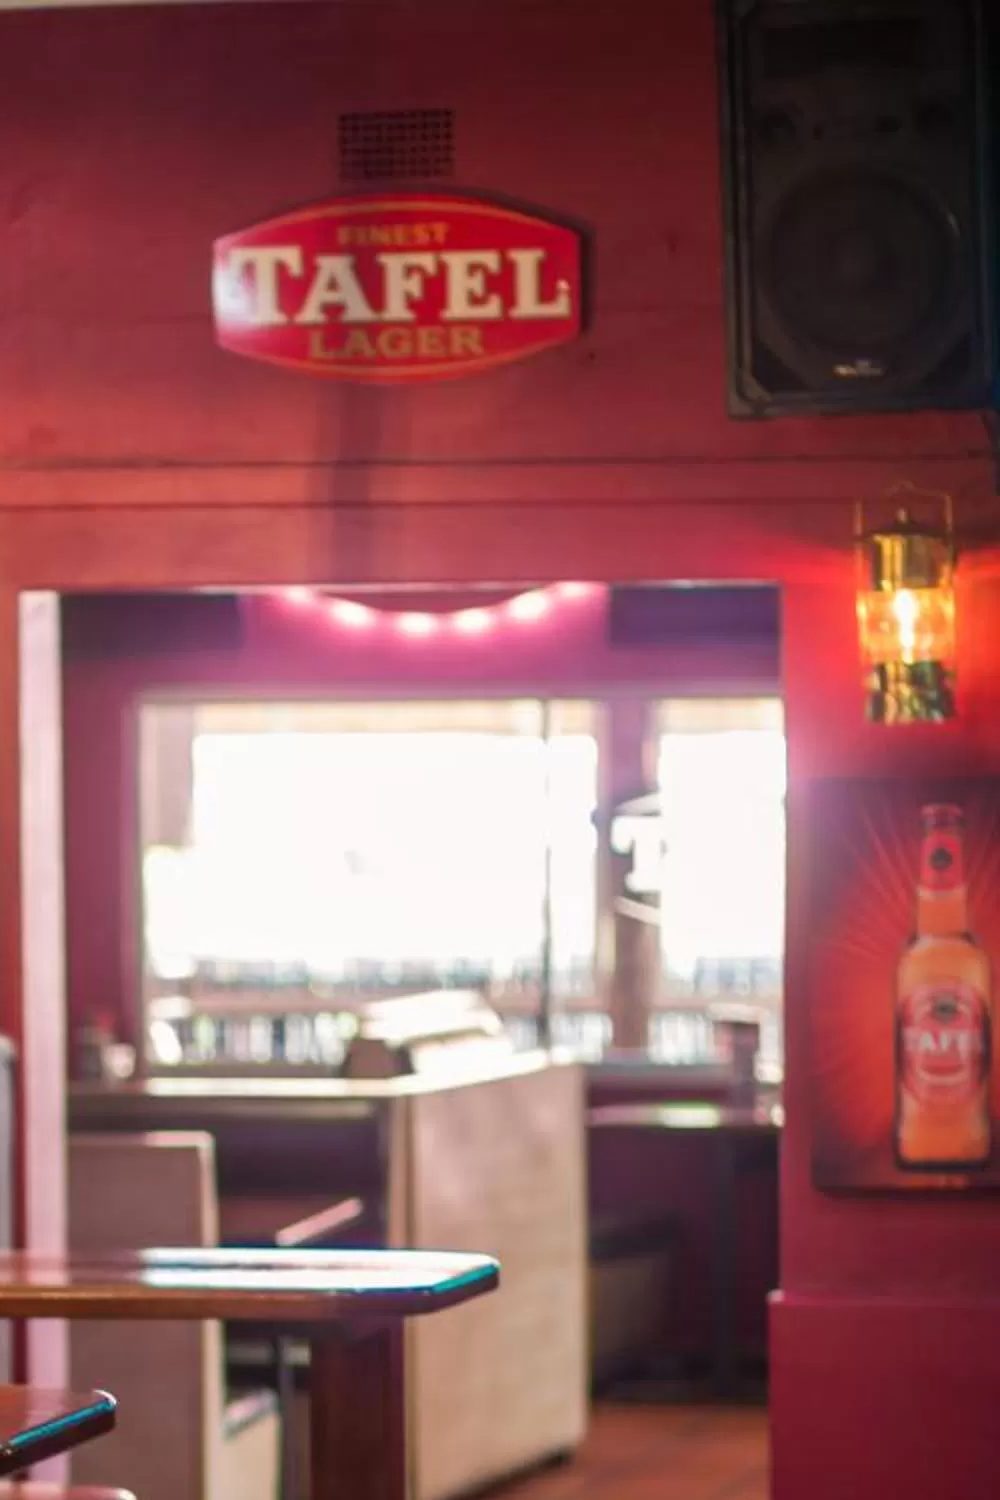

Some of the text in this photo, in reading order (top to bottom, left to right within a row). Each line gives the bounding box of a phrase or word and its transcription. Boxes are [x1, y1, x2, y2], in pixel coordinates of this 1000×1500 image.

[337, 221, 451, 246] FINEST
[228, 245, 573, 327] TAFEL
[310, 325, 485, 359] LAGER
